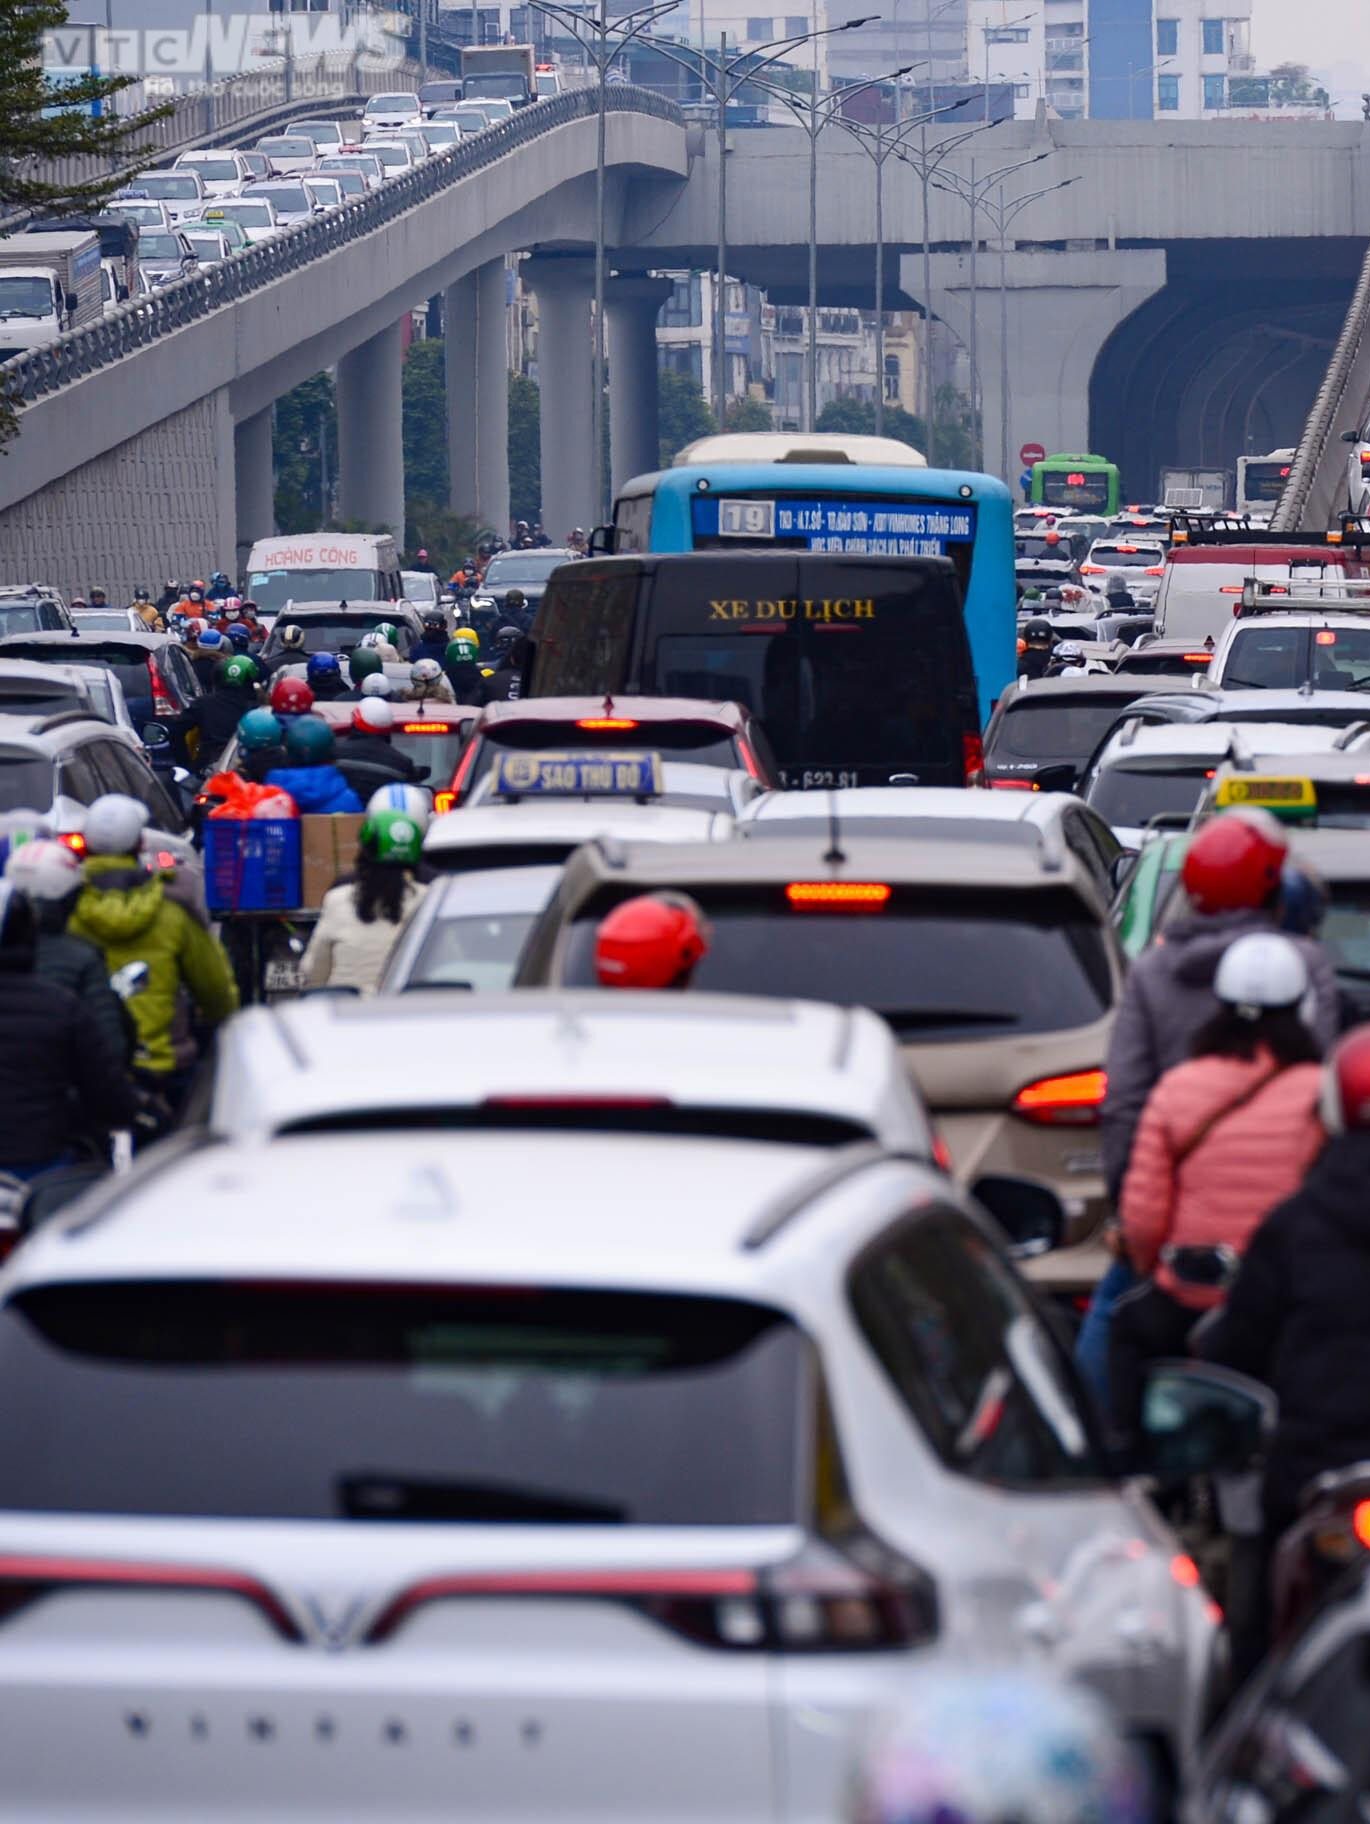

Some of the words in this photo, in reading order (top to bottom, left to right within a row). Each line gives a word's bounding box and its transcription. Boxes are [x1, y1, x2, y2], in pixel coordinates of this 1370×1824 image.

[727, 506, 766, 533] 19
[265, 545, 313, 567] HOÀNG
[319, 543, 358, 565] CÔNG
[708, 600, 749, 620] XE
[755, 599, 798, 619] DU
[804, 598, 876, 623] LỊCH
